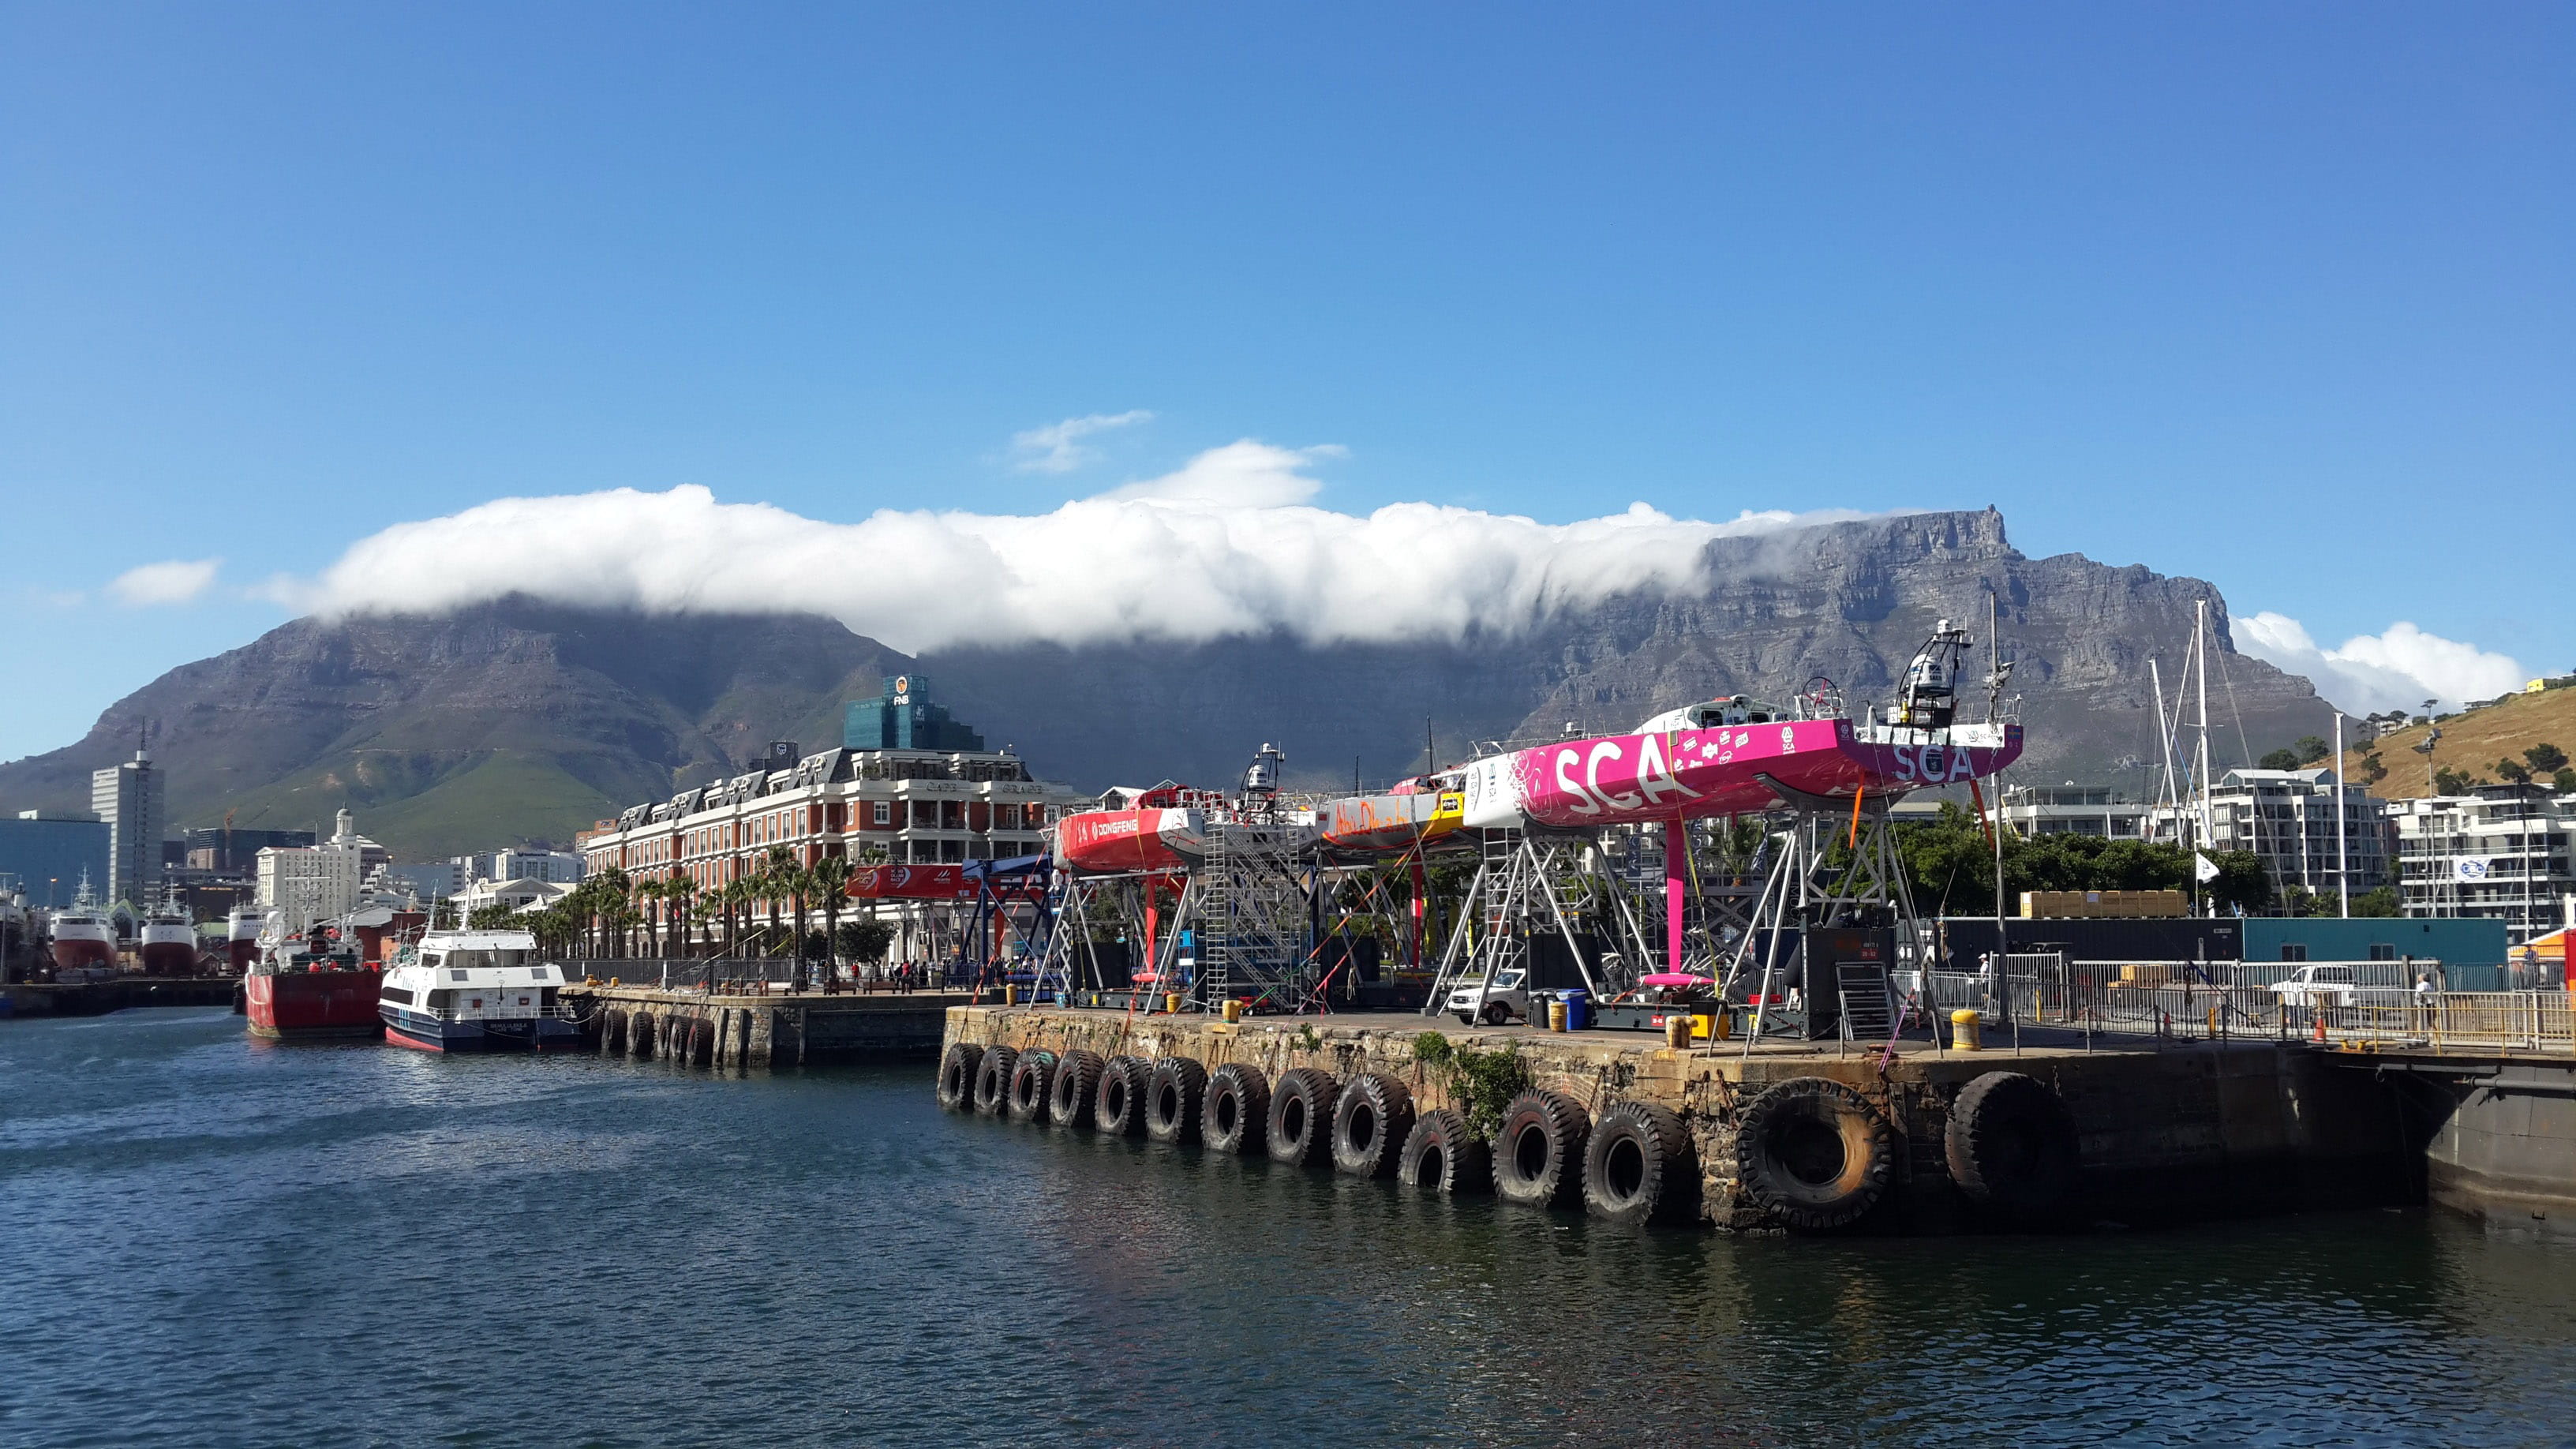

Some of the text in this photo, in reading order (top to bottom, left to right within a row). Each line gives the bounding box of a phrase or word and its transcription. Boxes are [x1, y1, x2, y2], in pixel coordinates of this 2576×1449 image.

[893, 695, 909, 706] FNB
[1891, 744, 1978, 782] SCA
[1556, 734, 1705, 814] SCA
[926, 781, 1043, 794] CAPE GRACE
[1098, 818, 1137, 836] DONGFENG
